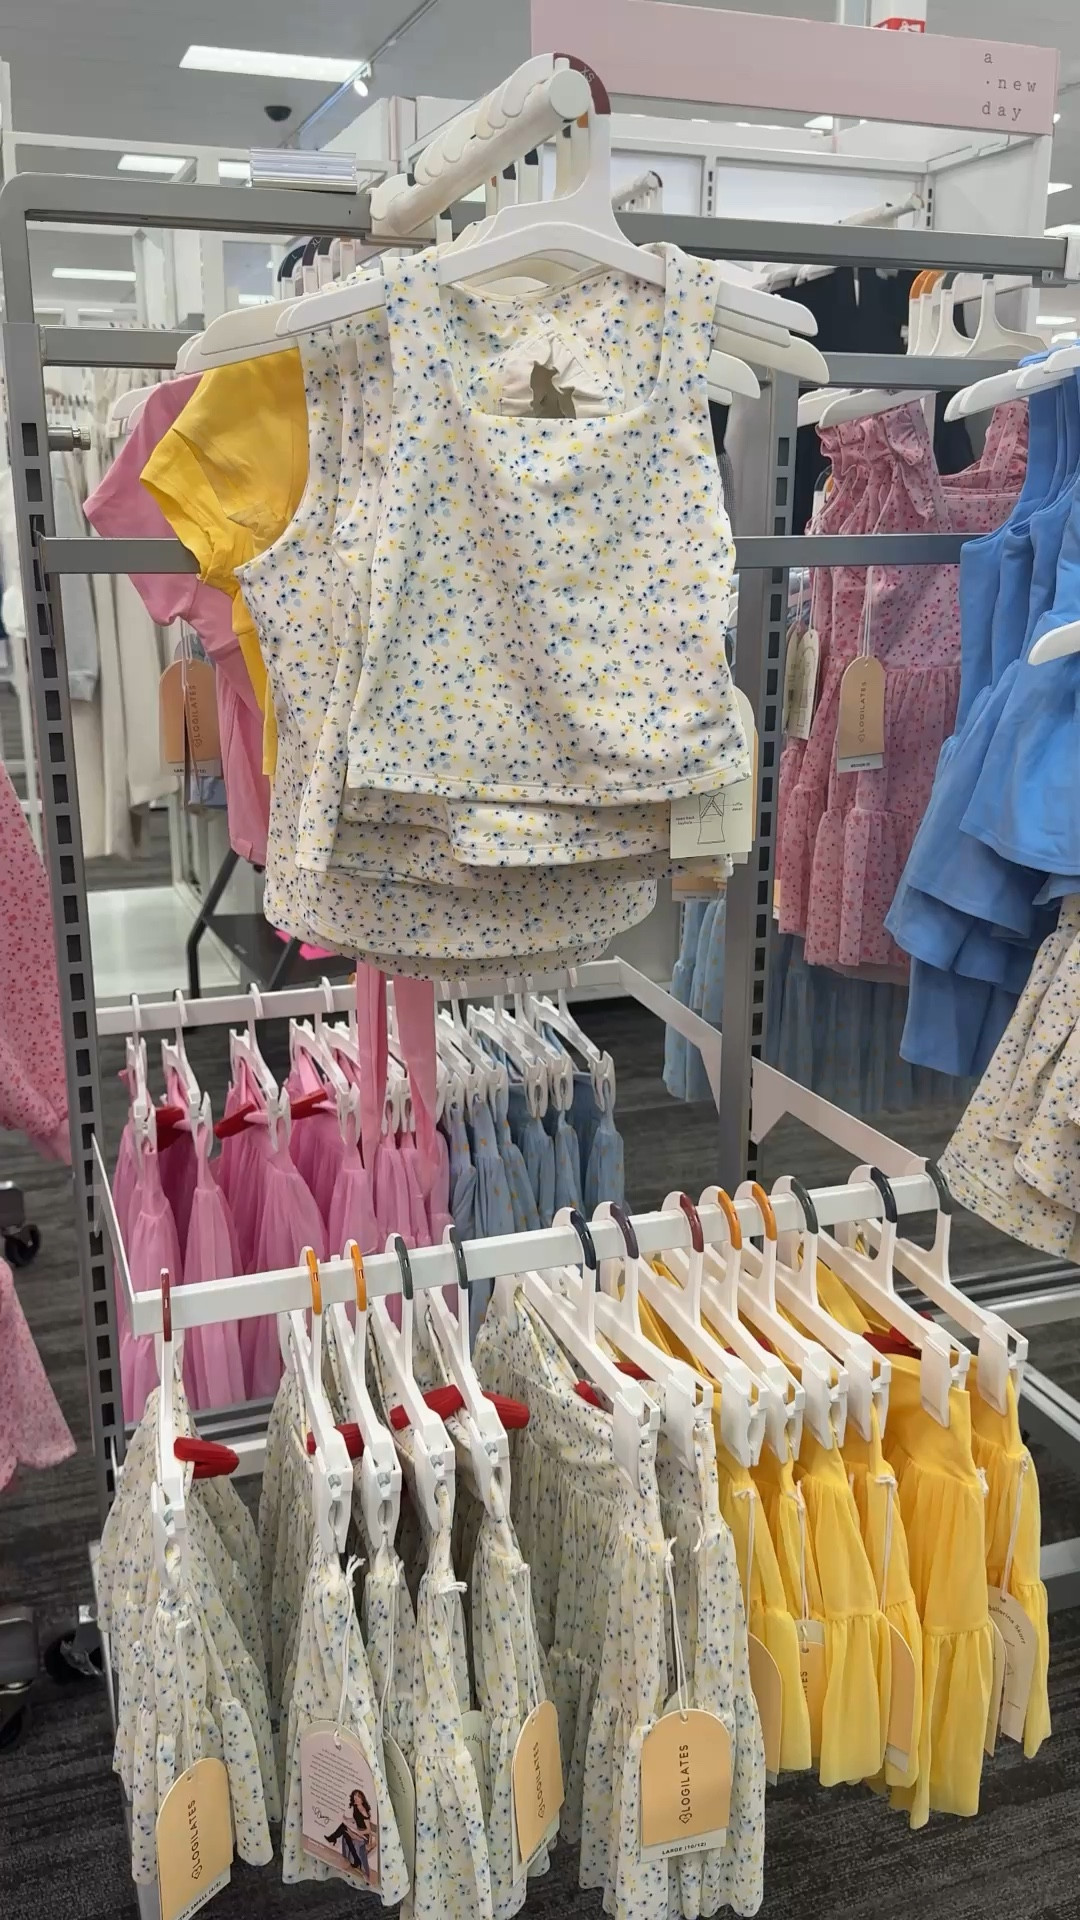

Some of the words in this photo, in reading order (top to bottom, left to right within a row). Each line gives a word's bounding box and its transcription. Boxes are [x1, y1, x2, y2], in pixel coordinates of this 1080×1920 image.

[984, 53, 993, 64] a
[981, 101, 1022, 121] day
[662, 1846, 683, 1855] LARGE
[190, 1893, 208, 1910] SMALL
